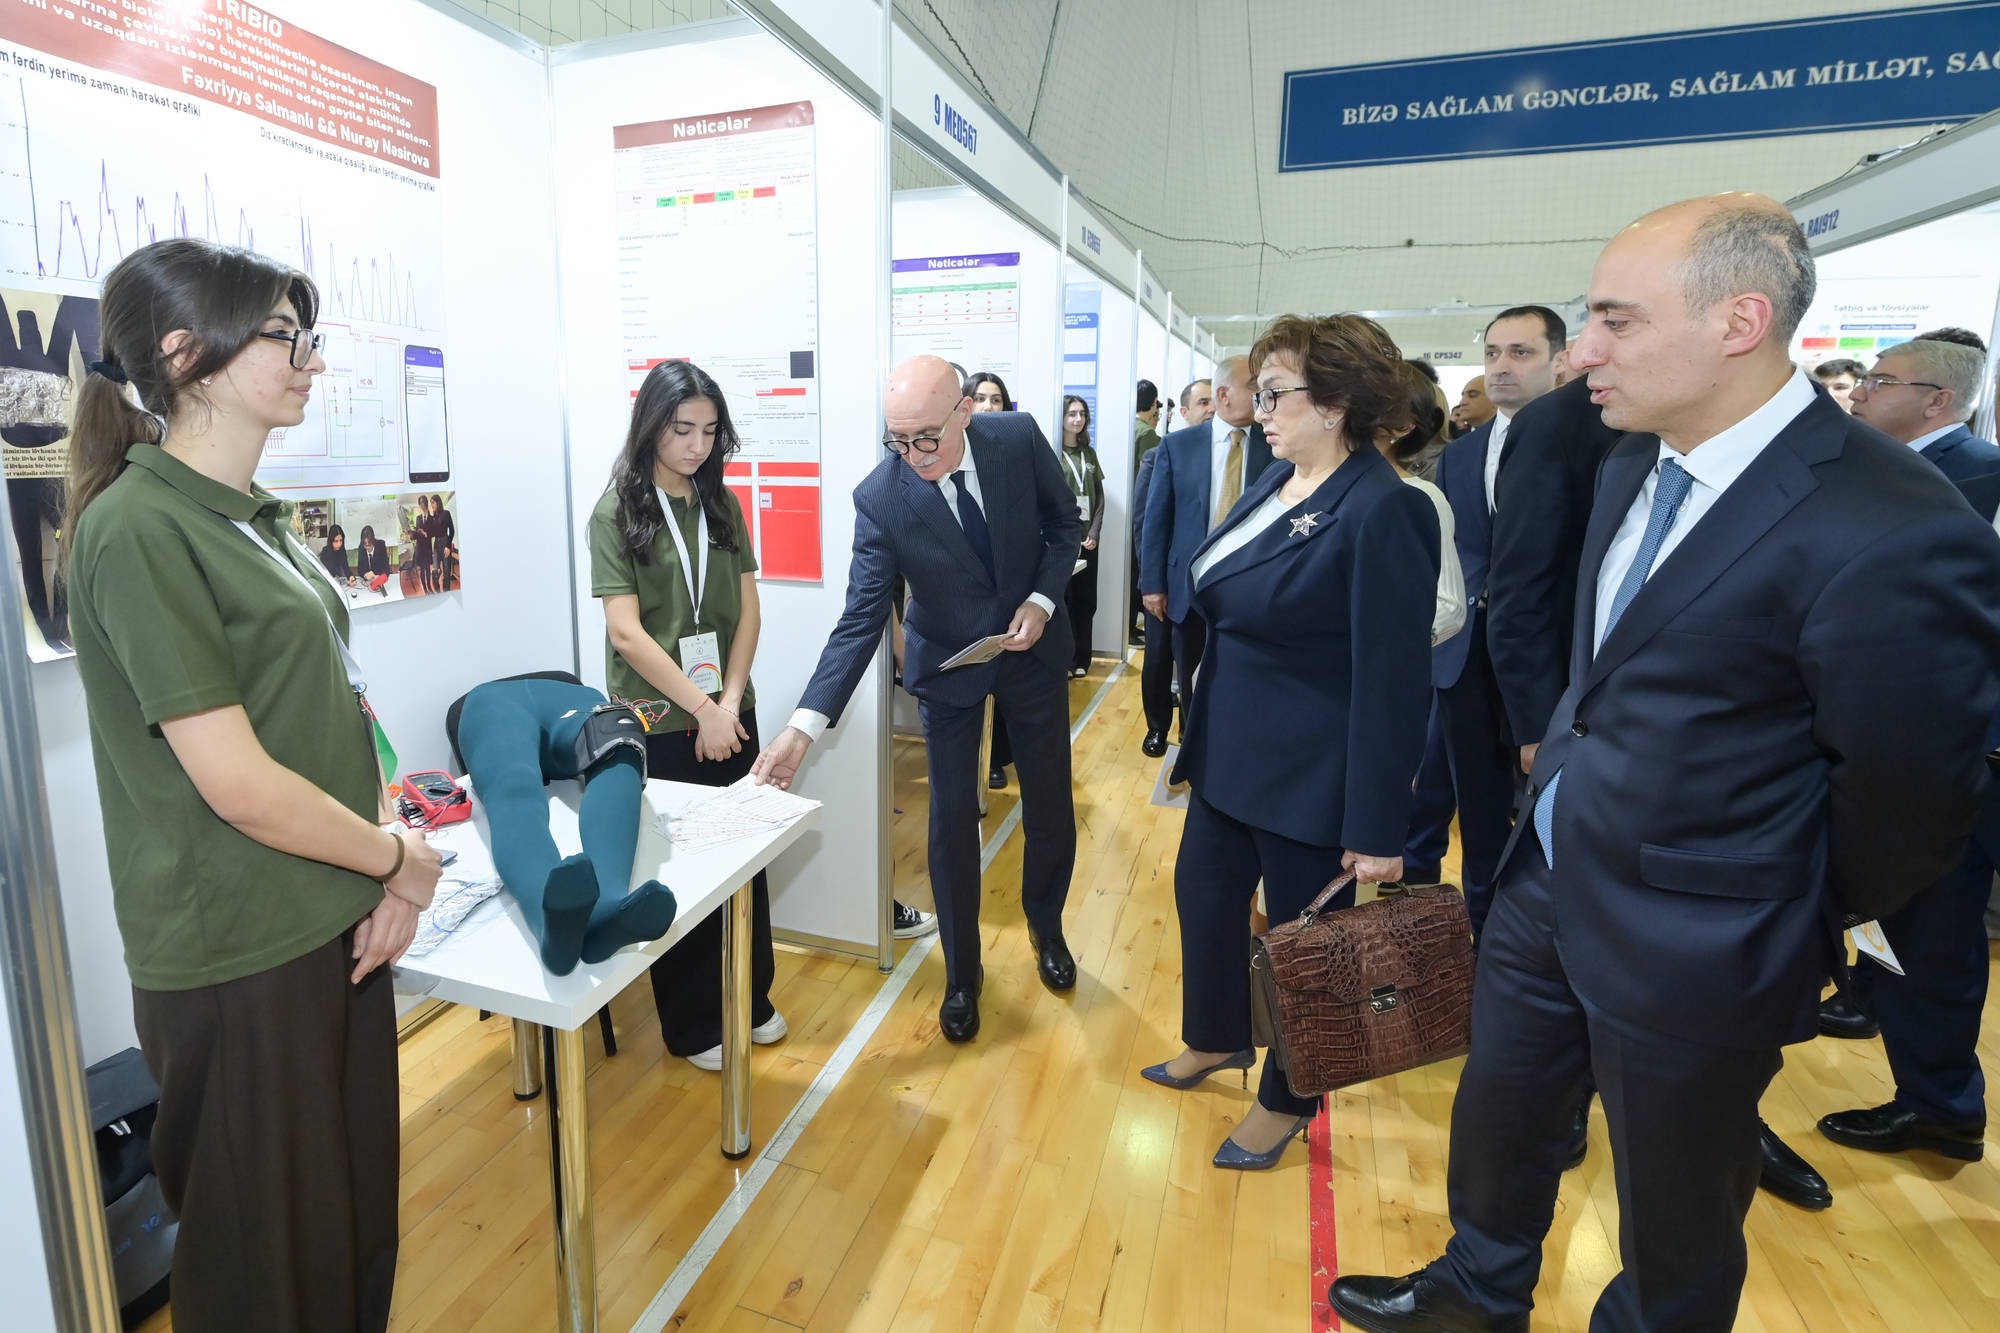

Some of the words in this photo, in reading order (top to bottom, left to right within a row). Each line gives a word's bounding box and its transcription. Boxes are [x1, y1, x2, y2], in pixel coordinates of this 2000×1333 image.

[53, 4, 75, 20] və
[81, 15, 160, 48] uzaqdan
[219, 44, 237, 60] bu
[1342, 103, 1398, 125] BİZƏ
[1405, 94, 1514, 121] SAĞLAM
[1522, 82, 1659, 110] GƏNCLƏR,
[1669, 68, 1797, 98] SAĞLAM
[1806, 55, 1935, 87] MİLLƏT,
[255, 92, 314, 130] Salmanlı
[317, 115, 338, 138] &&
[340, 123, 380, 154] Nuray
[382, 137, 430, 169] Nəsirova
[672, 116, 752, 138] Nəticələr
[934, 94, 941, 126] 9
[945, 102, 978, 155] MED567
[928, 257, 980, 269] Nəticələr
